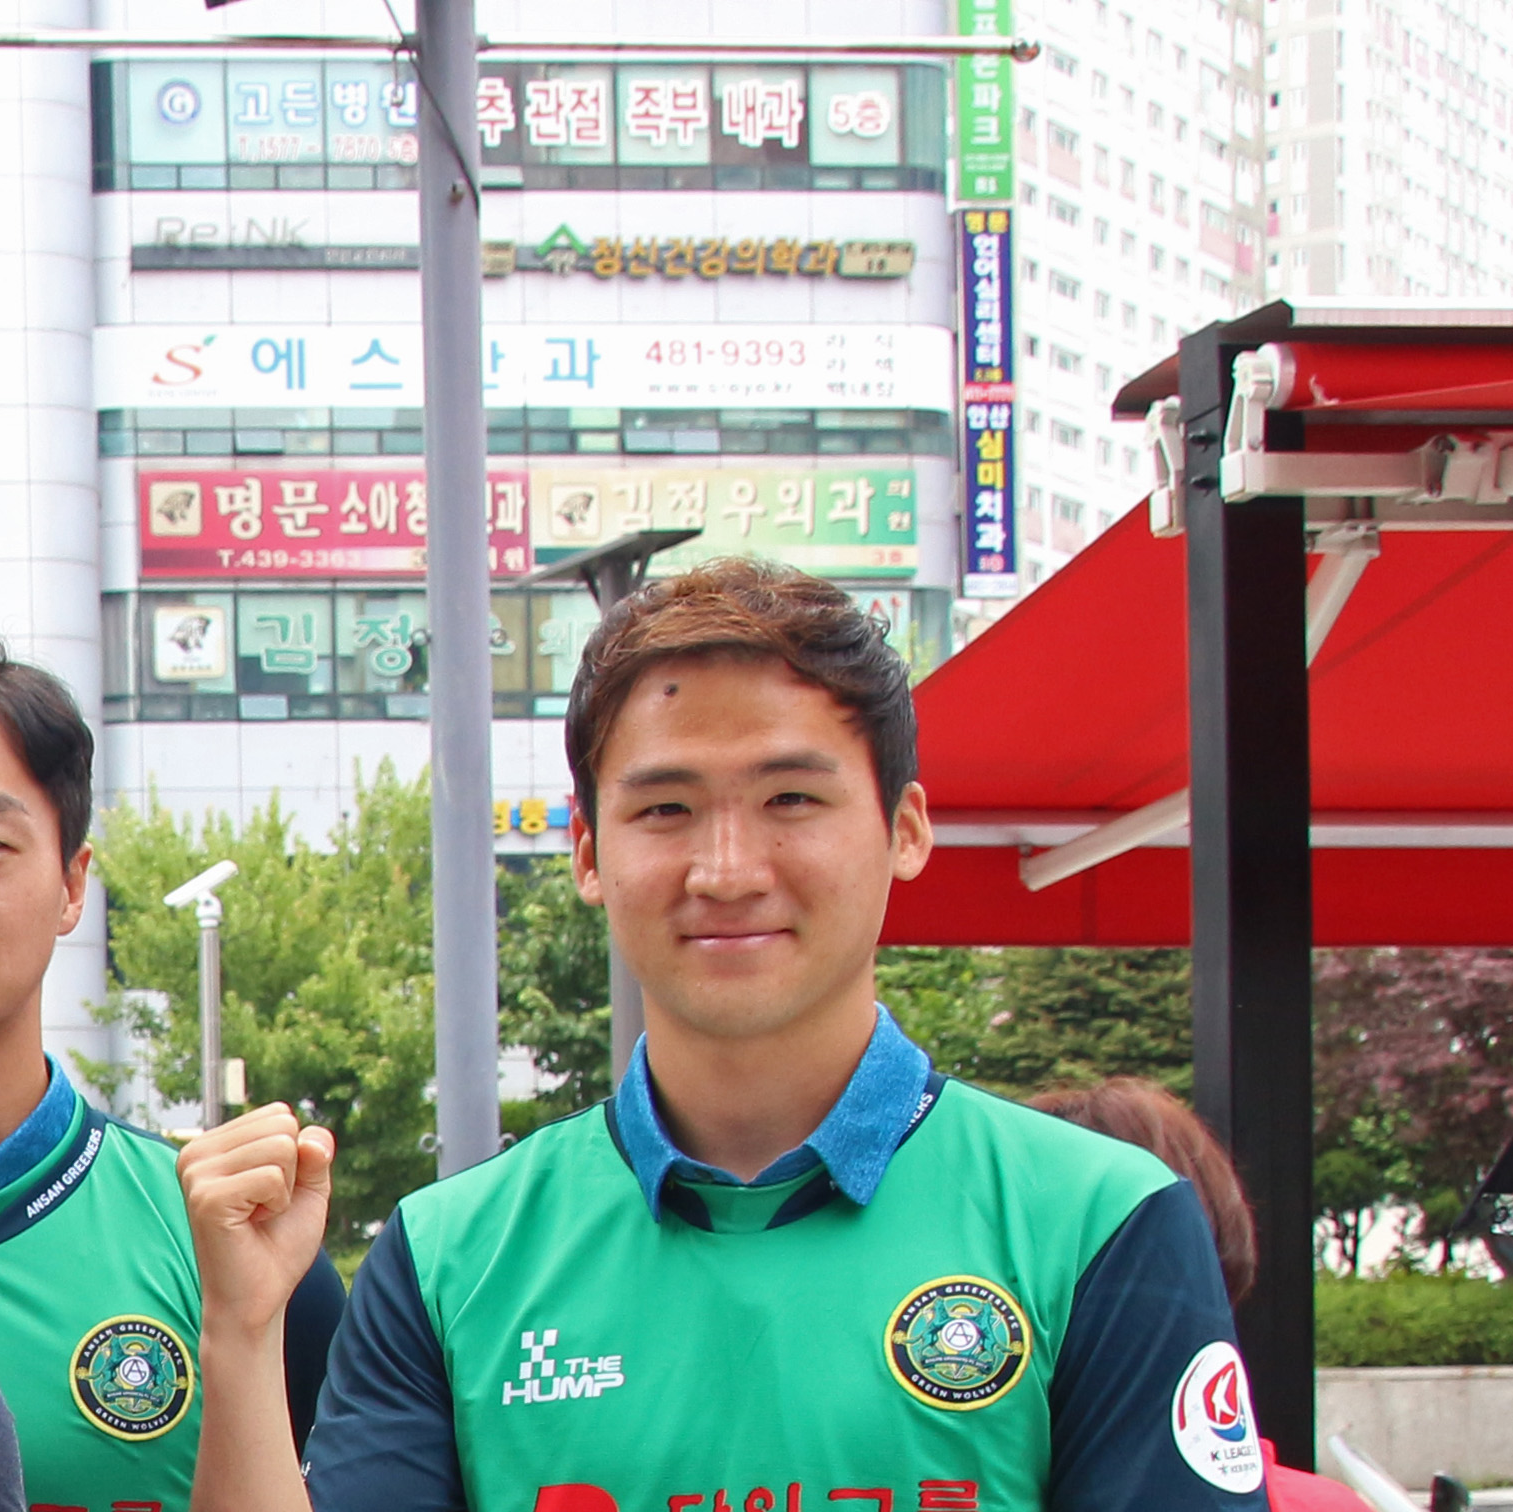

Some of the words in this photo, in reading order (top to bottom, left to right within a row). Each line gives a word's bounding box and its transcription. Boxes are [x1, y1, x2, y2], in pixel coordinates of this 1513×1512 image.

[475, 78, 515, 147] 추
[525, 79, 609, 147] 관절
[625, 79, 711, 148] 족부
[720, 79, 804, 147] 내과
[825, 90, 893, 138] 5층
[645, 339, 807, 367] 481-9393
[213, 477, 329, 539] 명문
[339, 481, 526, 535] 소아청과
[610, 477, 877, 538] 김정우외과
[26, 1179, 66, 1219] ANSAN
[62, 1127, 103, 1185] GREENERS
[902, 1290, 938, 1322] ANSAN
[945, 1285, 1008, 1311] GREENERS
[84, 1328, 114, 1358] ANSAN
[119, 1324, 174, 1349] GREENERS
[564, 1355, 622, 1375] THE
[502, 1372, 625, 1406] HUMP
[911, 1374, 949, 1398] GREEN
[953, 1382, 998, 1400] WOLVES
[95, 1407, 128, 1429] GREEN
[132, 1414, 170, 1431] WOLVES
